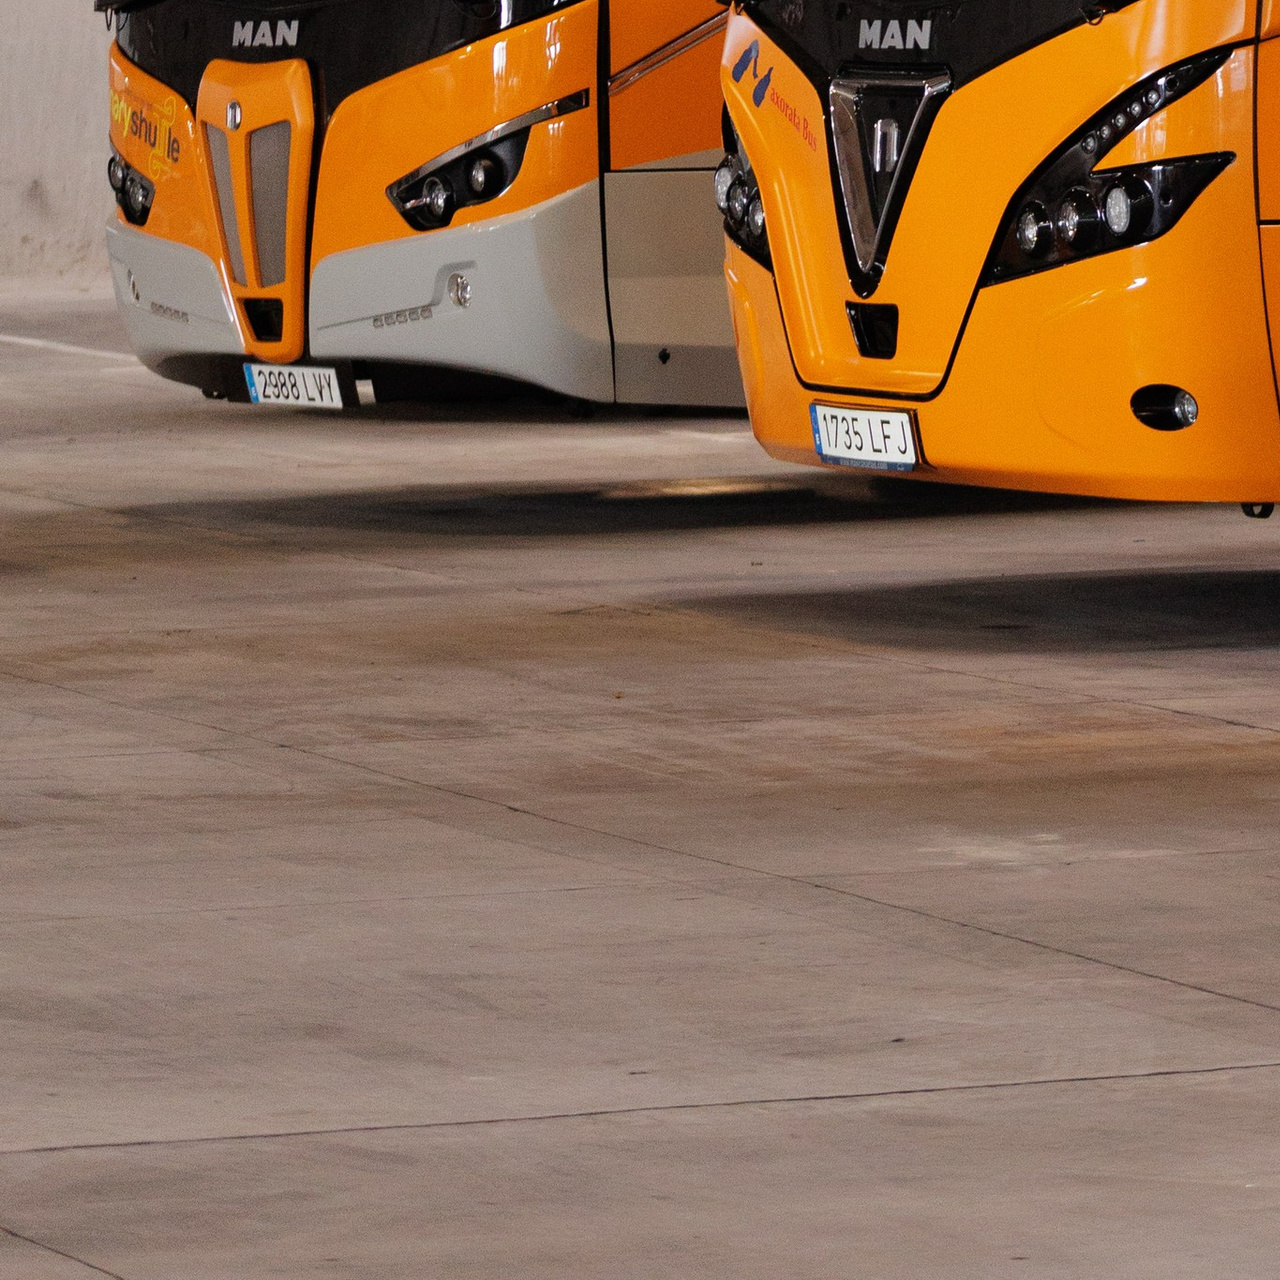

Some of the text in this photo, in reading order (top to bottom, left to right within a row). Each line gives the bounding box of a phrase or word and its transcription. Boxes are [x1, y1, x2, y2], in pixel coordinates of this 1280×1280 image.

[232, 19, 299, 47] MAN
[858, 19, 931, 49] MAN
[803, 118, 818, 152] Bus
[258, 370, 334, 402] 2988 LVY
[823, 413, 863, 451] 1735
[868, 418, 907, 455] LFJ
